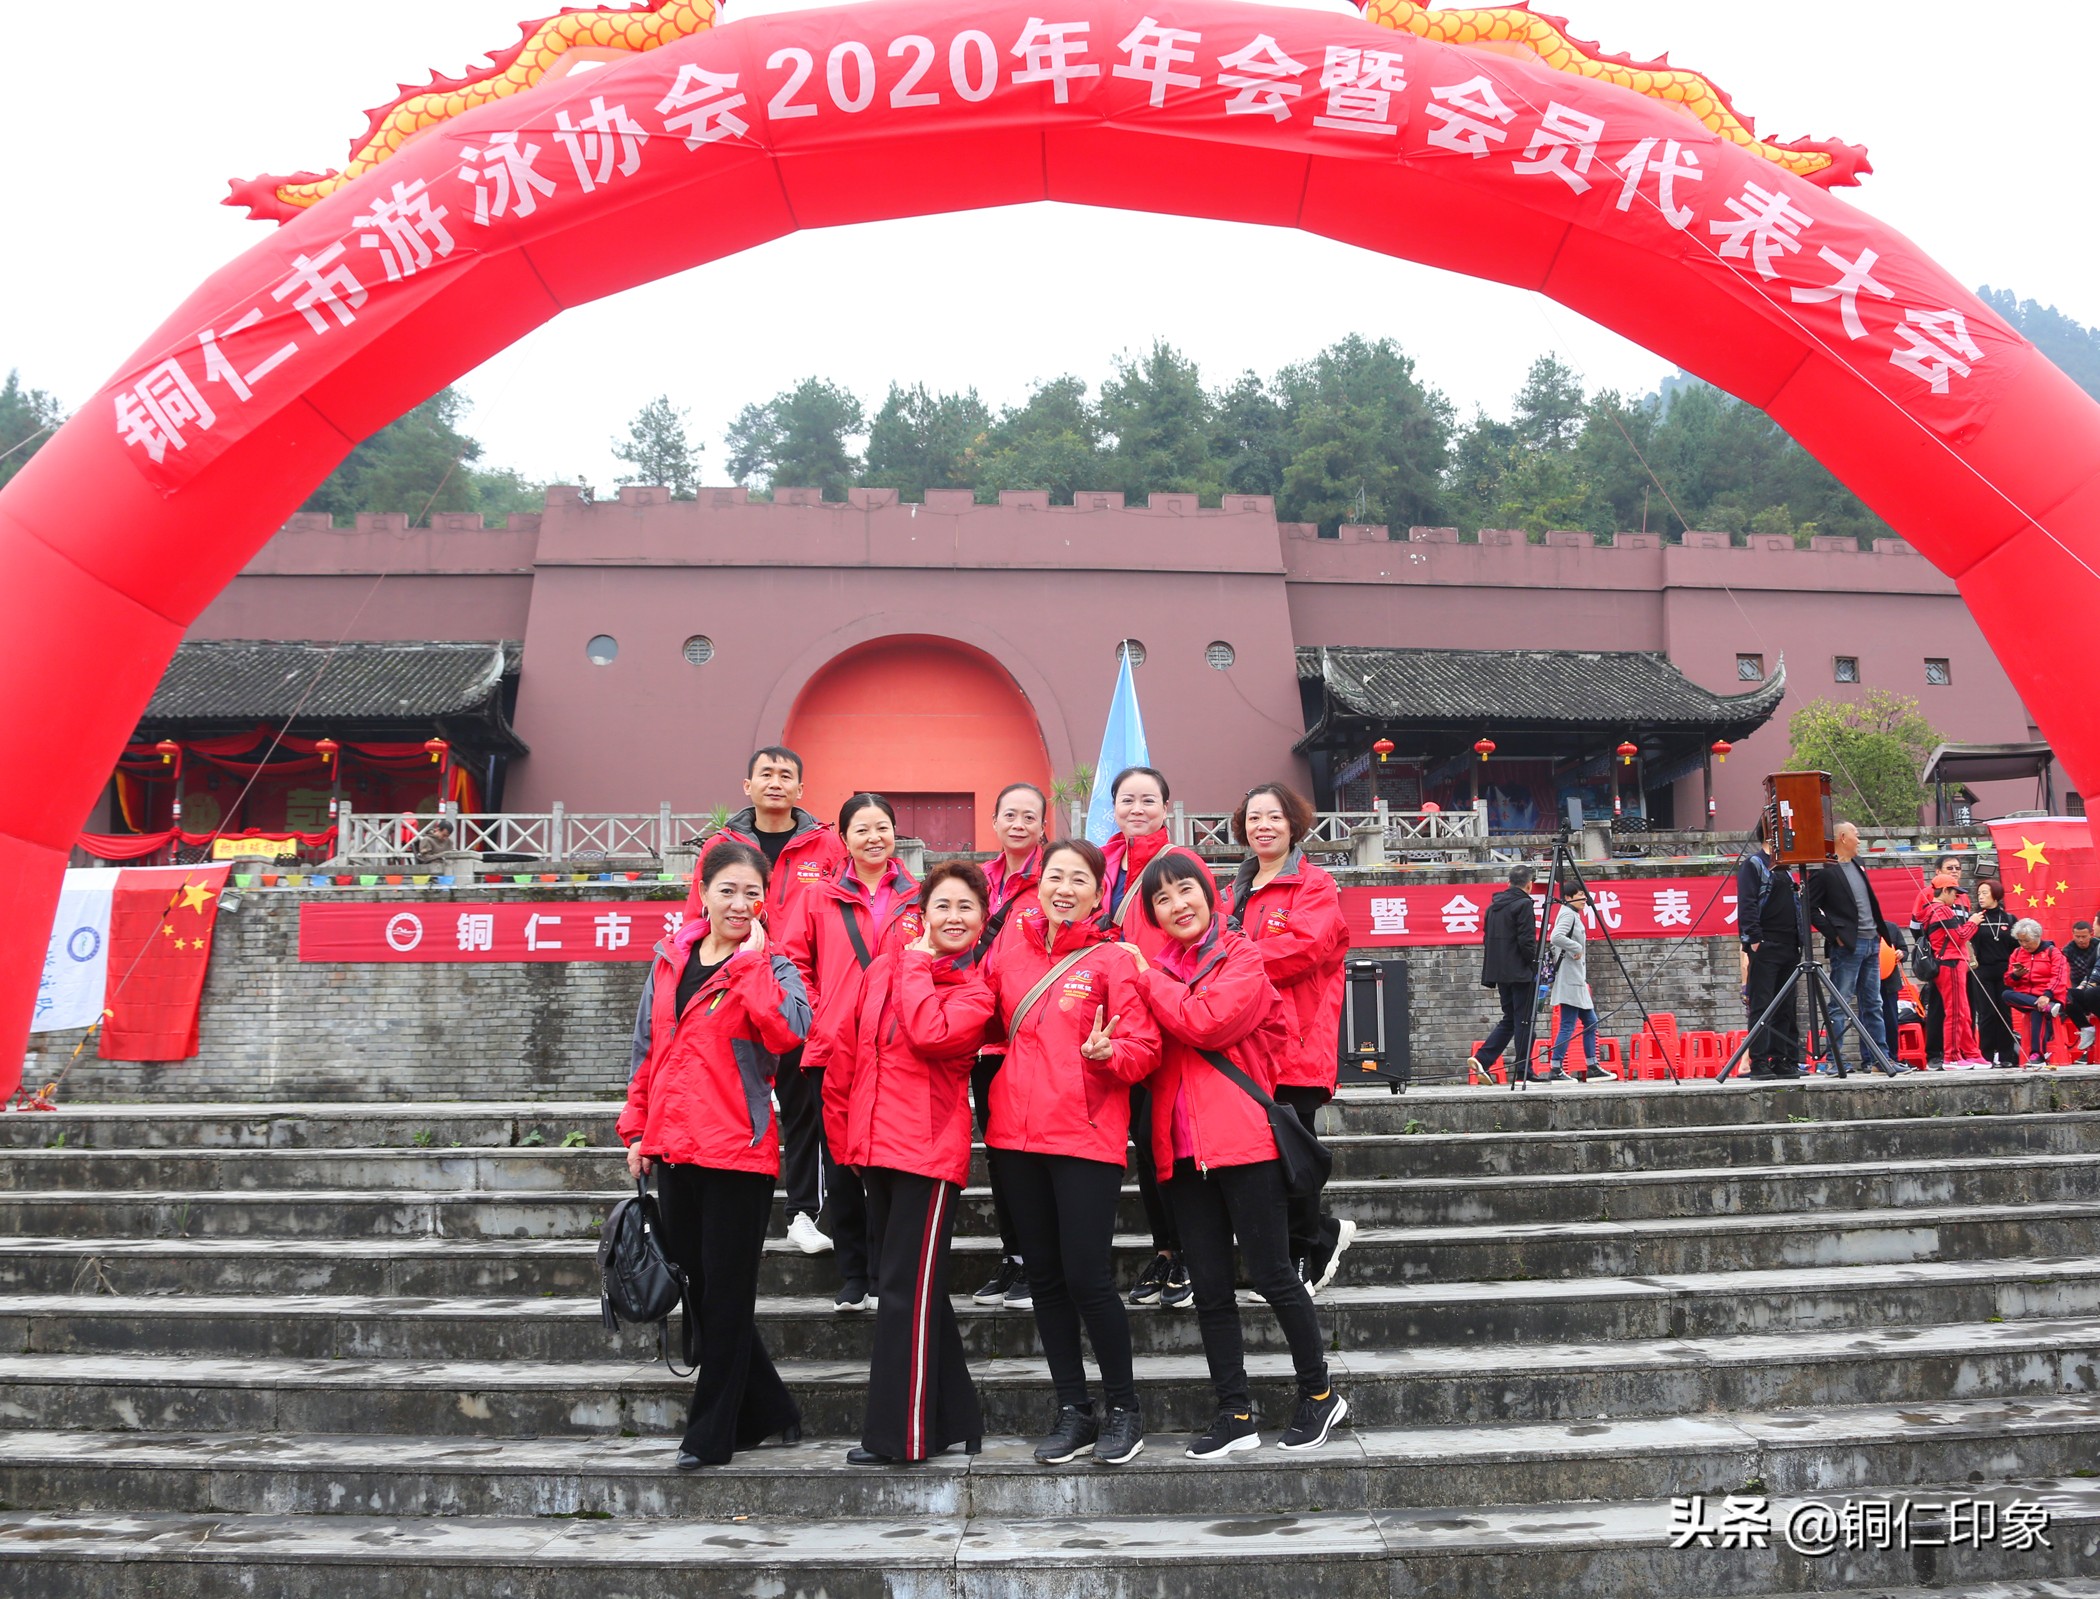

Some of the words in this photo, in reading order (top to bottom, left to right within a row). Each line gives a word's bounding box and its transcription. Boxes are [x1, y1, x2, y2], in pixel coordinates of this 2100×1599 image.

[113, 15, 1985, 465] 铜仁市游泳协会2020年年会暨会员代表大会
